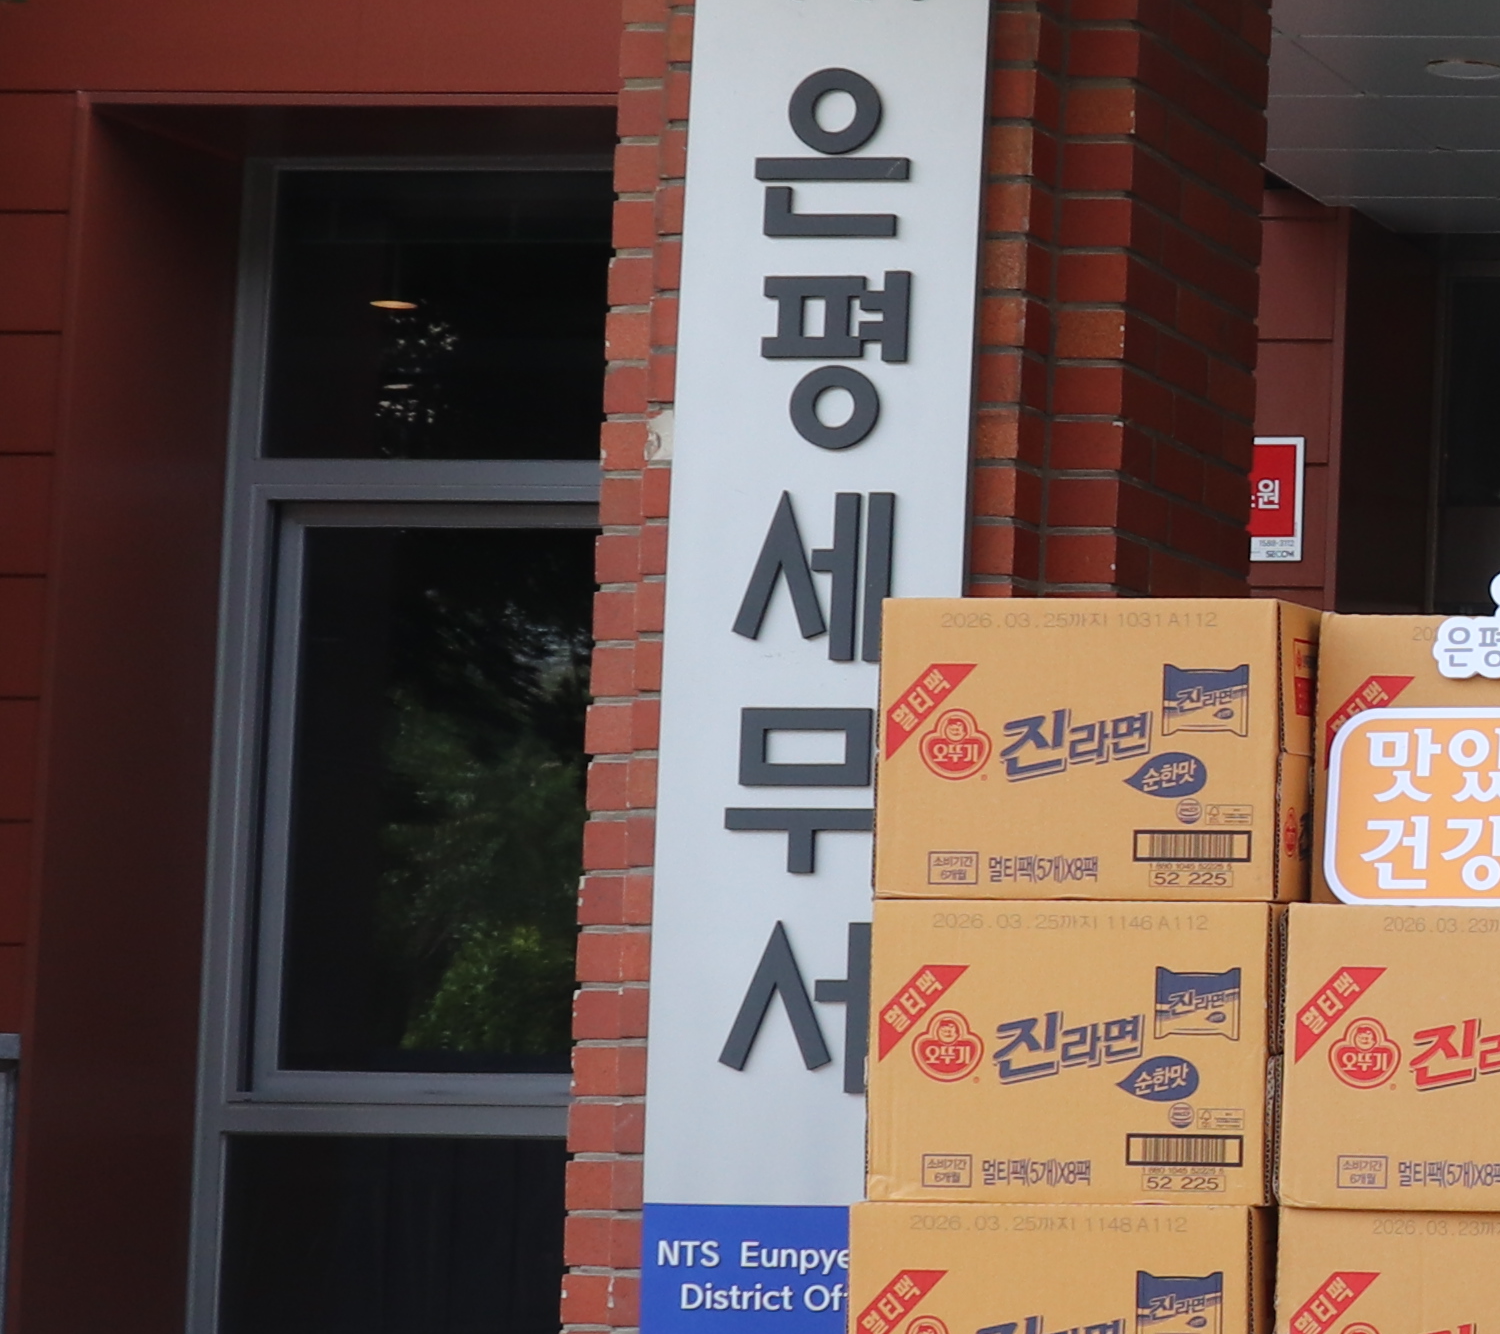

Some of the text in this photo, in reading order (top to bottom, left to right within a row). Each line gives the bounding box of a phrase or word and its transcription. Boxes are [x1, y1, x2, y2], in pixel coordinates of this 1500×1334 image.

[1251, 479, 1279, 509] 원
[718, 66, 912, 1097] 은평세무서
[890, 668, 951, 730] 멀티팩
[932, 746, 979, 763] 오뚜기
[999, 707, 1154, 782] 진라면
[1140, 759, 1199, 792] 순한맛
[1187, 872, 1226, 886] 225
[991, 1009, 1146, 1086] 진라면
[657, 1240, 720, 1267] NTS
[680, 1282, 849, 1311] District Of
